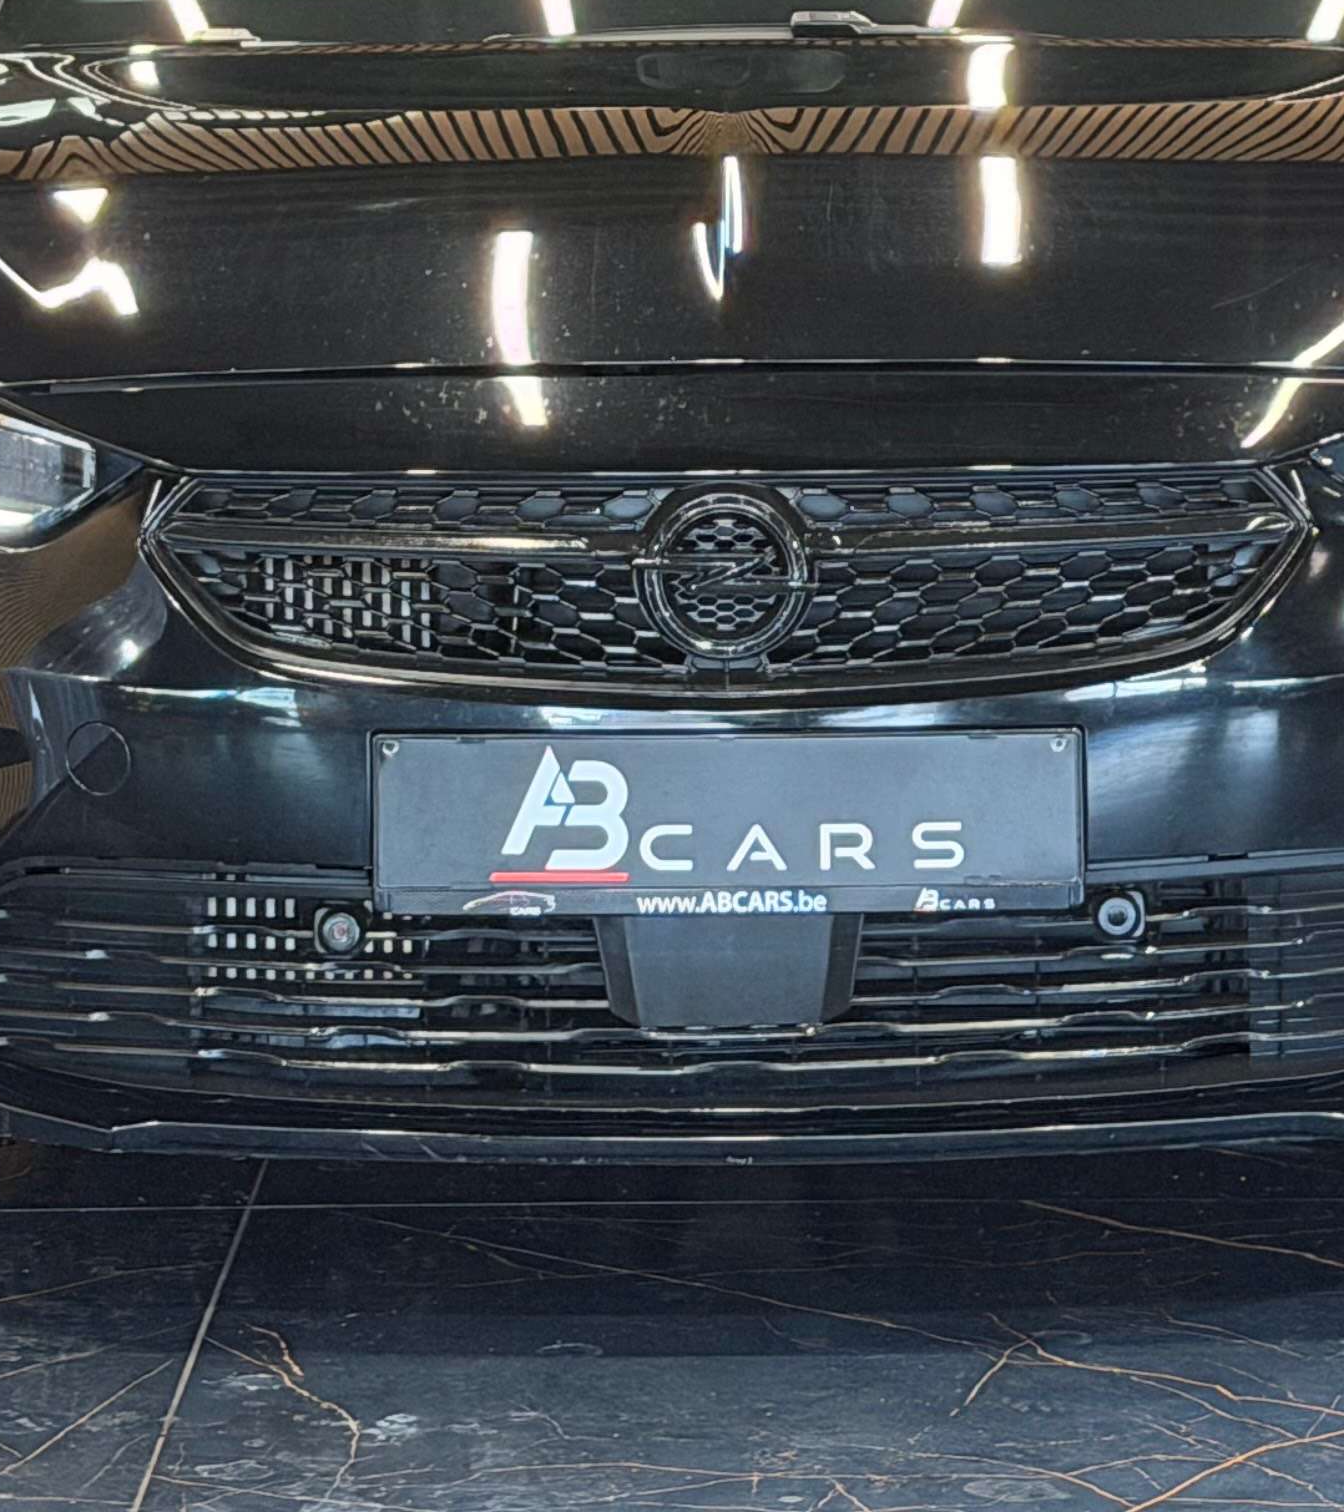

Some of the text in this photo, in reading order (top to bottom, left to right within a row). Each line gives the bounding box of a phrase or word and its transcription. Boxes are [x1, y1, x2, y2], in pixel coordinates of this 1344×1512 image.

[501, 745, 965, 871] AB CARS
[636, 890, 827, 913] www.ABCARS.be
[939, 898, 996, 910] CARS
